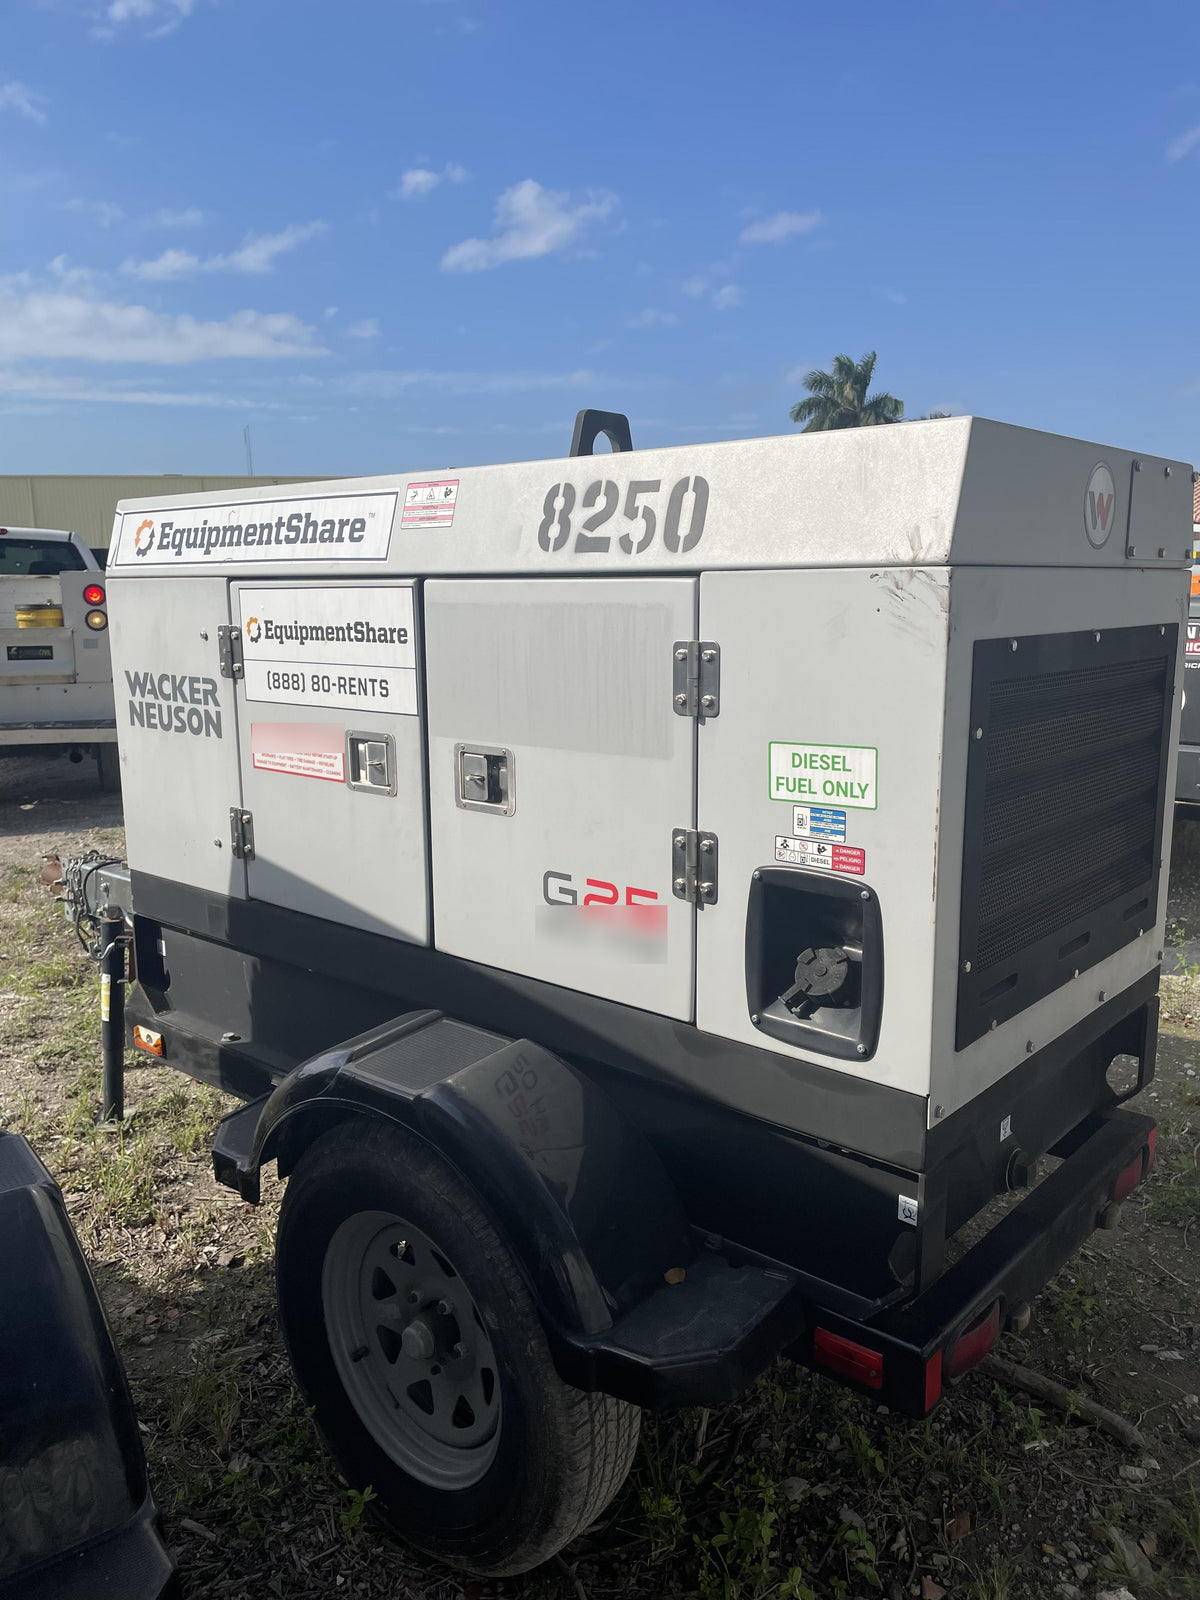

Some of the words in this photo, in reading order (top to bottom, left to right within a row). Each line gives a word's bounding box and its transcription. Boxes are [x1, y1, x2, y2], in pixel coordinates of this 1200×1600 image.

[538, 475, 710, 555] 8250
[157, 512, 366, 556] EquipmentShare
[263, 620, 408, 645] EquipmentShare
[124, 670, 221, 707] WACKER
[267, 670, 306, 693] (888)
[311, 674, 389, 698] 80-RENTS
[129, 700, 223, 739] NEUSON
[791, 752, 852, 772] DIESEL
[775, 776, 817, 795] FUEL
[822, 780, 869, 799] ONLY
[810, 857, 831, 866] DIESEL
[839, 848, 861, 856] DANGER
[839, 856, 862, 864] PELIGRO
[839, 864, 861, 872] DANGER
